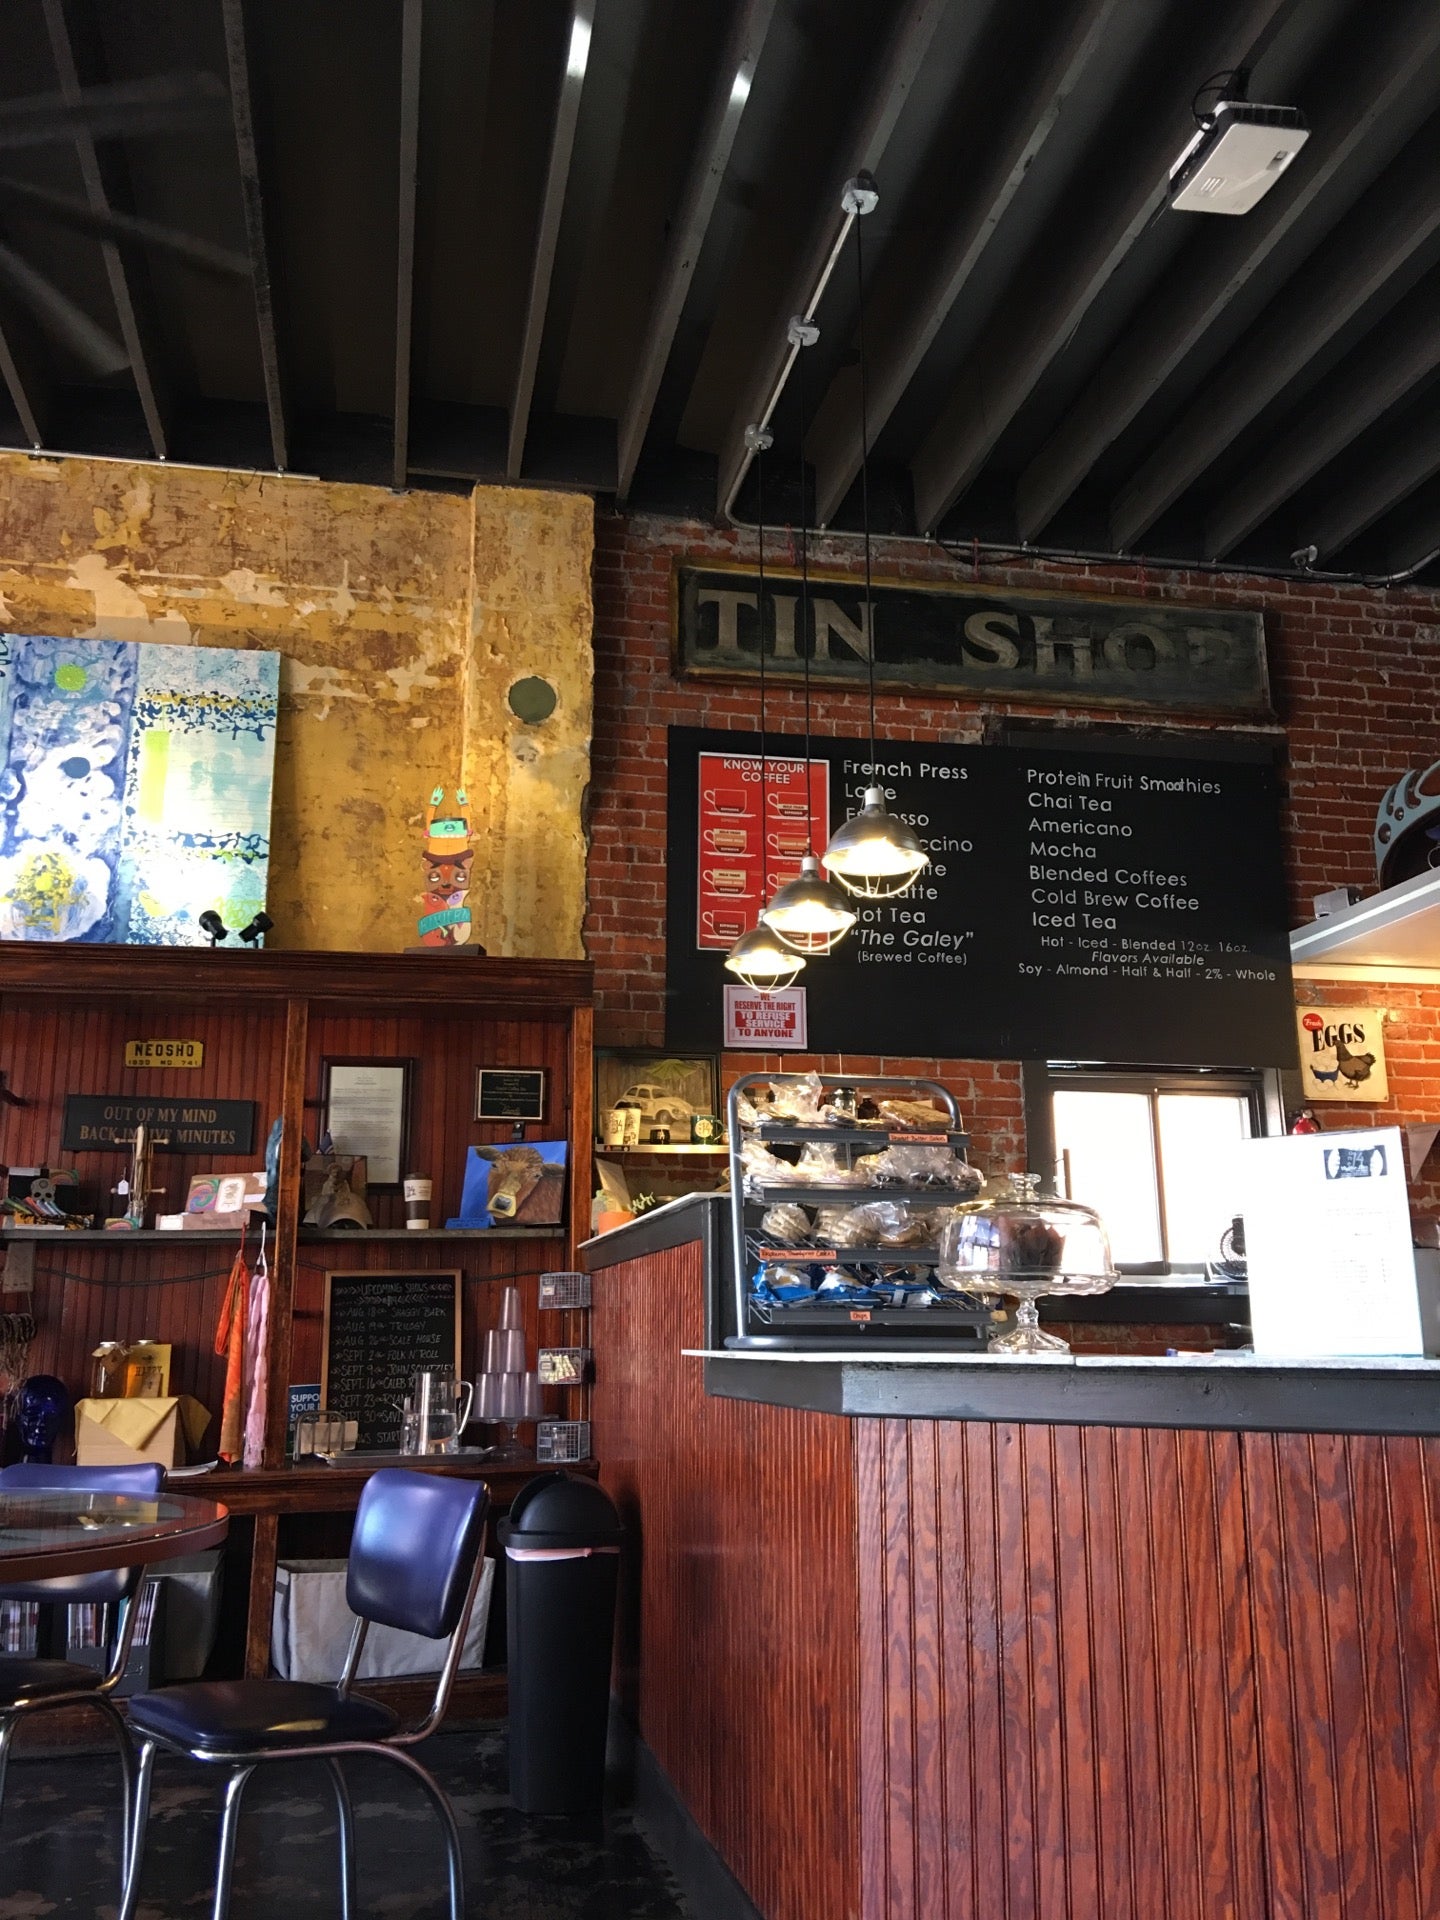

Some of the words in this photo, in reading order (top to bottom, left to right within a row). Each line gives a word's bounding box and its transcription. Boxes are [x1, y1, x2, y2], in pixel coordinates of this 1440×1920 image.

[698, 588, 877, 663] TIN
[723, 759, 763, 771] KNOW
[768, 762, 805, 774] YOUR
[843, 760, 912, 777] French
[920, 763, 968, 780] Press
[741, 772, 791, 784] COFFEE
[1027, 769, 1090, 787] Protein
[1095, 773, 1134, 789] Fruit
[1139, 775, 1221, 794] Smoothies
[1028, 792, 1073, 809] Chai
[1078, 796, 1112, 812] Tea
[1028, 817, 1133, 837] Americano
[1030, 841, 1097, 859] Mocha
[1029, 865, 1108, 883] Blended
[1114, 869, 1187, 887] Coffees
[887, 883, 938, 900] Latte
[1031, 888, 1077, 905] Cold
[1084, 890, 1129, 907] Brew
[1135, 893, 1199, 911] Coffee
[890, 907, 926, 924] Tea
[1032, 912, 1076, 928] Iced
[1082, 913, 1117, 930] Tea
[850, 929, 895, 946] "The
[903, 930, 974, 950] Galey"
[1041, 936, 1064, 948] Hot
[1078, 937, 1108, 949] Iced
[1121, 938, 1176, 950] Blended
[857, 950, 912, 963] (Brewed
[917, 952, 967, 966] Coffee)
[1091, 951, 1138, 963] Flavors
[1142, 953, 1205, 966] Available
[1018, 963, 1043, 977] Soy
[1056, 963, 1108, 976] Almond
[1121, 966, 1147, 977] Half
[1152, 967, 1162, 978] &
[1166, 967, 1192, 978] Half
[1205, 968, 1223, 980] 2%
[1235, 969, 1276, 981] Whole
[734, 1001, 762, 1010] RESERVE
[764, 1002, 775, 1011] THE
[776, 1002, 796, 1011] RIGHT
[742, 1011, 754, 1020] TO
[755, 1011, 791, 1021] REFUSE
[746, 1020, 786, 1029] SERVICE
[738, 1028, 752, 1037] TO
[753, 1028, 794, 1038] ANYONE
[1312, 1023, 1366, 1052] EGGS
[134, 1044, 195, 1057] NEOSHO
[103, 1106, 133, 1122] OUT
[136, 1107, 154, 1122] OF
[157, 1108, 180, 1123] MY
[182, 1108, 218, 1124] MIND
[79, 1125, 118, 1141] BACK
[176, 1129, 236, 1145] MINUTES
[290, 1403, 315, 1412] YOUR
